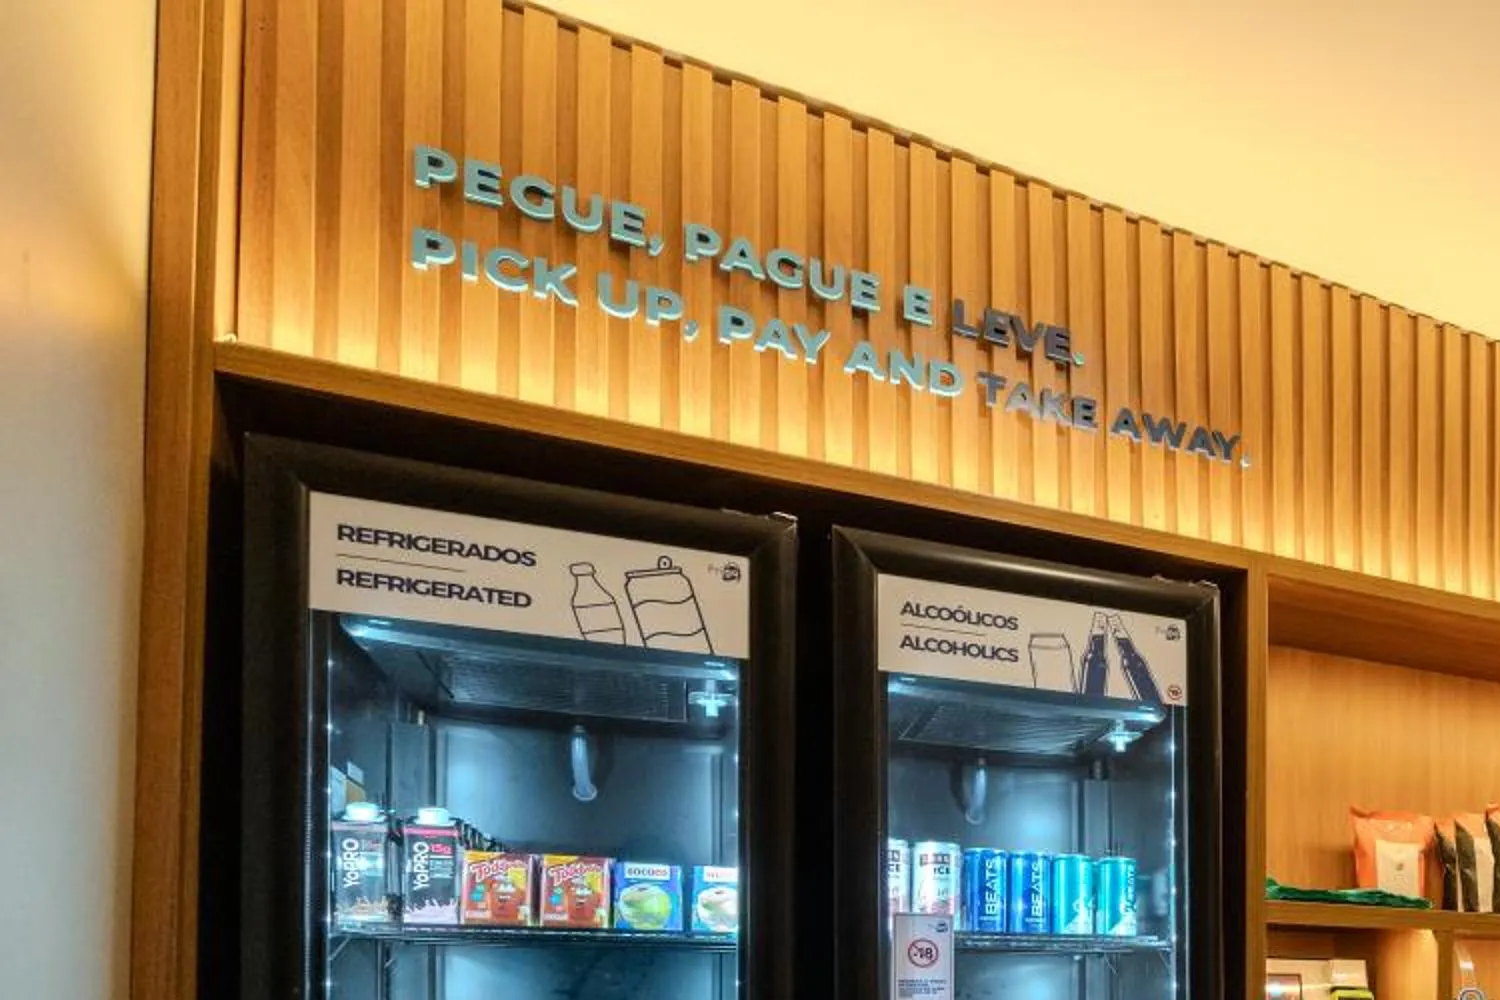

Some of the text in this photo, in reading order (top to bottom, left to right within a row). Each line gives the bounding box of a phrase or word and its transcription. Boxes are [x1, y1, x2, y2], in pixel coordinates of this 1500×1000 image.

[413, 145, 1086, 367] PEGUE, PAGUE E LEVE.
[411, 227, 1252, 468] PICK UP, PAY AND TAKE AWAY.
[336, 523, 538, 568] REFRIGERADOS
[336, 568, 533, 610] REFRIGERATED
[900, 600, 1019, 631] ALCOÓLICOS
[900, 634, 1020, 663] ALCOHOLICS
[342, 837, 361, 889] YoPRO
[413, 840, 430, 891] YoPRO
